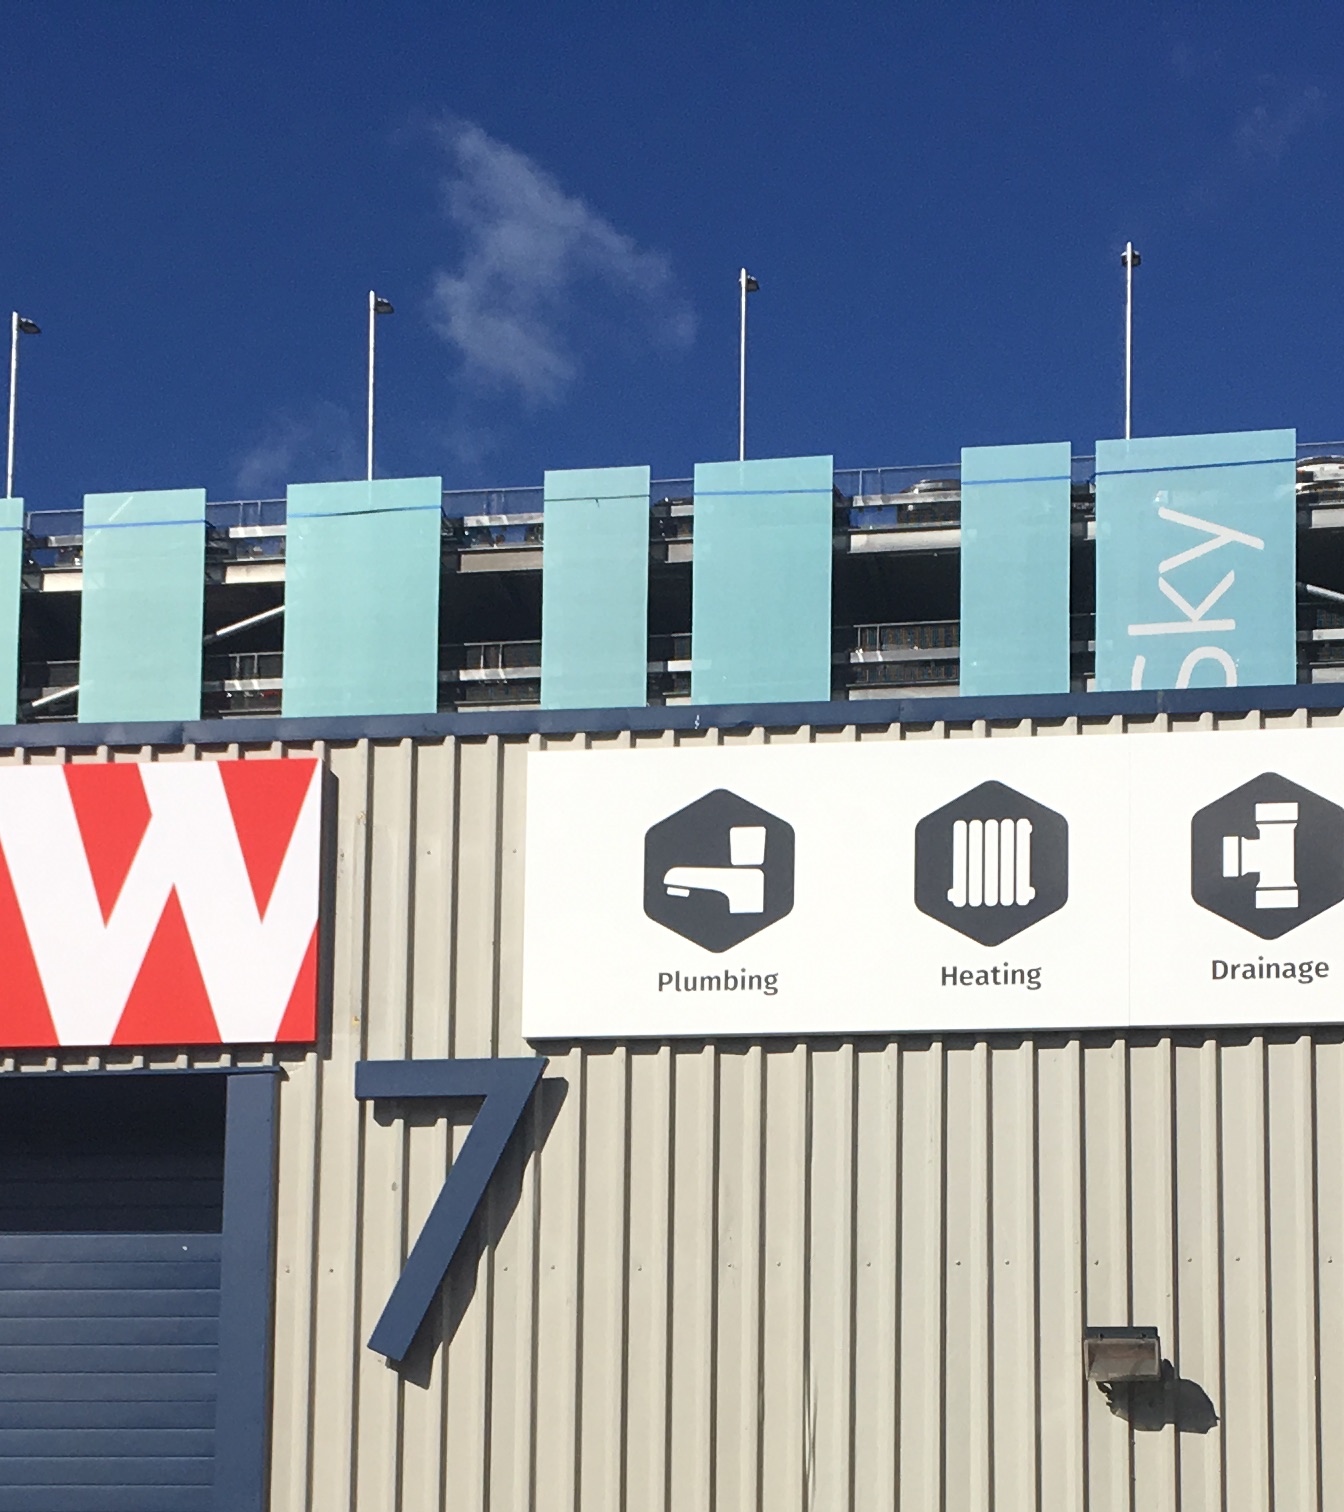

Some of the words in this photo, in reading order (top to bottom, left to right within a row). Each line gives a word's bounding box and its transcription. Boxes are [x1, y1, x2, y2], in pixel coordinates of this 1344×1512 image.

[1128, 506, 1265, 691] Sky
[657, 967, 779, 996] Plumbing
[940, 962, 1043, 991] Heating
[1211, 955, 1330, 984] Drainage
[354, 1057, 550, 1362] 7
